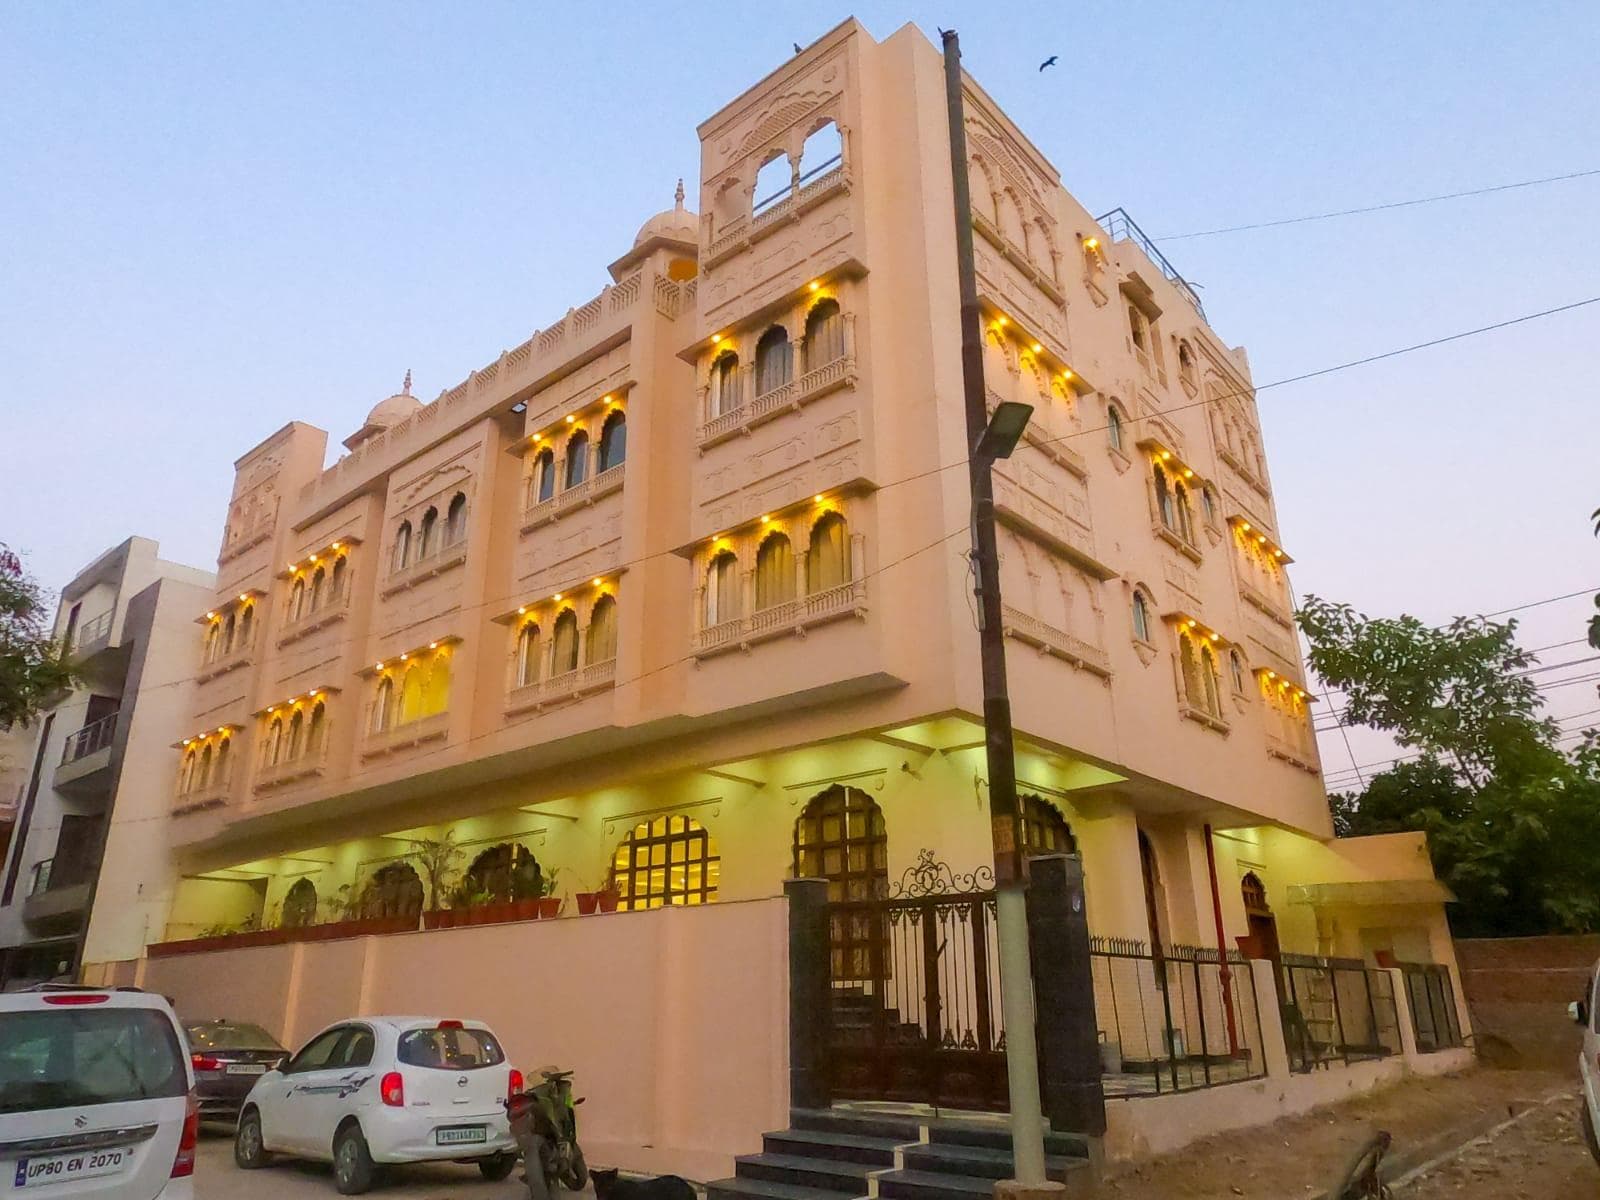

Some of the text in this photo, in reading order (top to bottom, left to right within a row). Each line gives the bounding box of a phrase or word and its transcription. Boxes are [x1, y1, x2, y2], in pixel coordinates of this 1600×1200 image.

[28, 1153, 122, 1178] UP80 EN 2070
